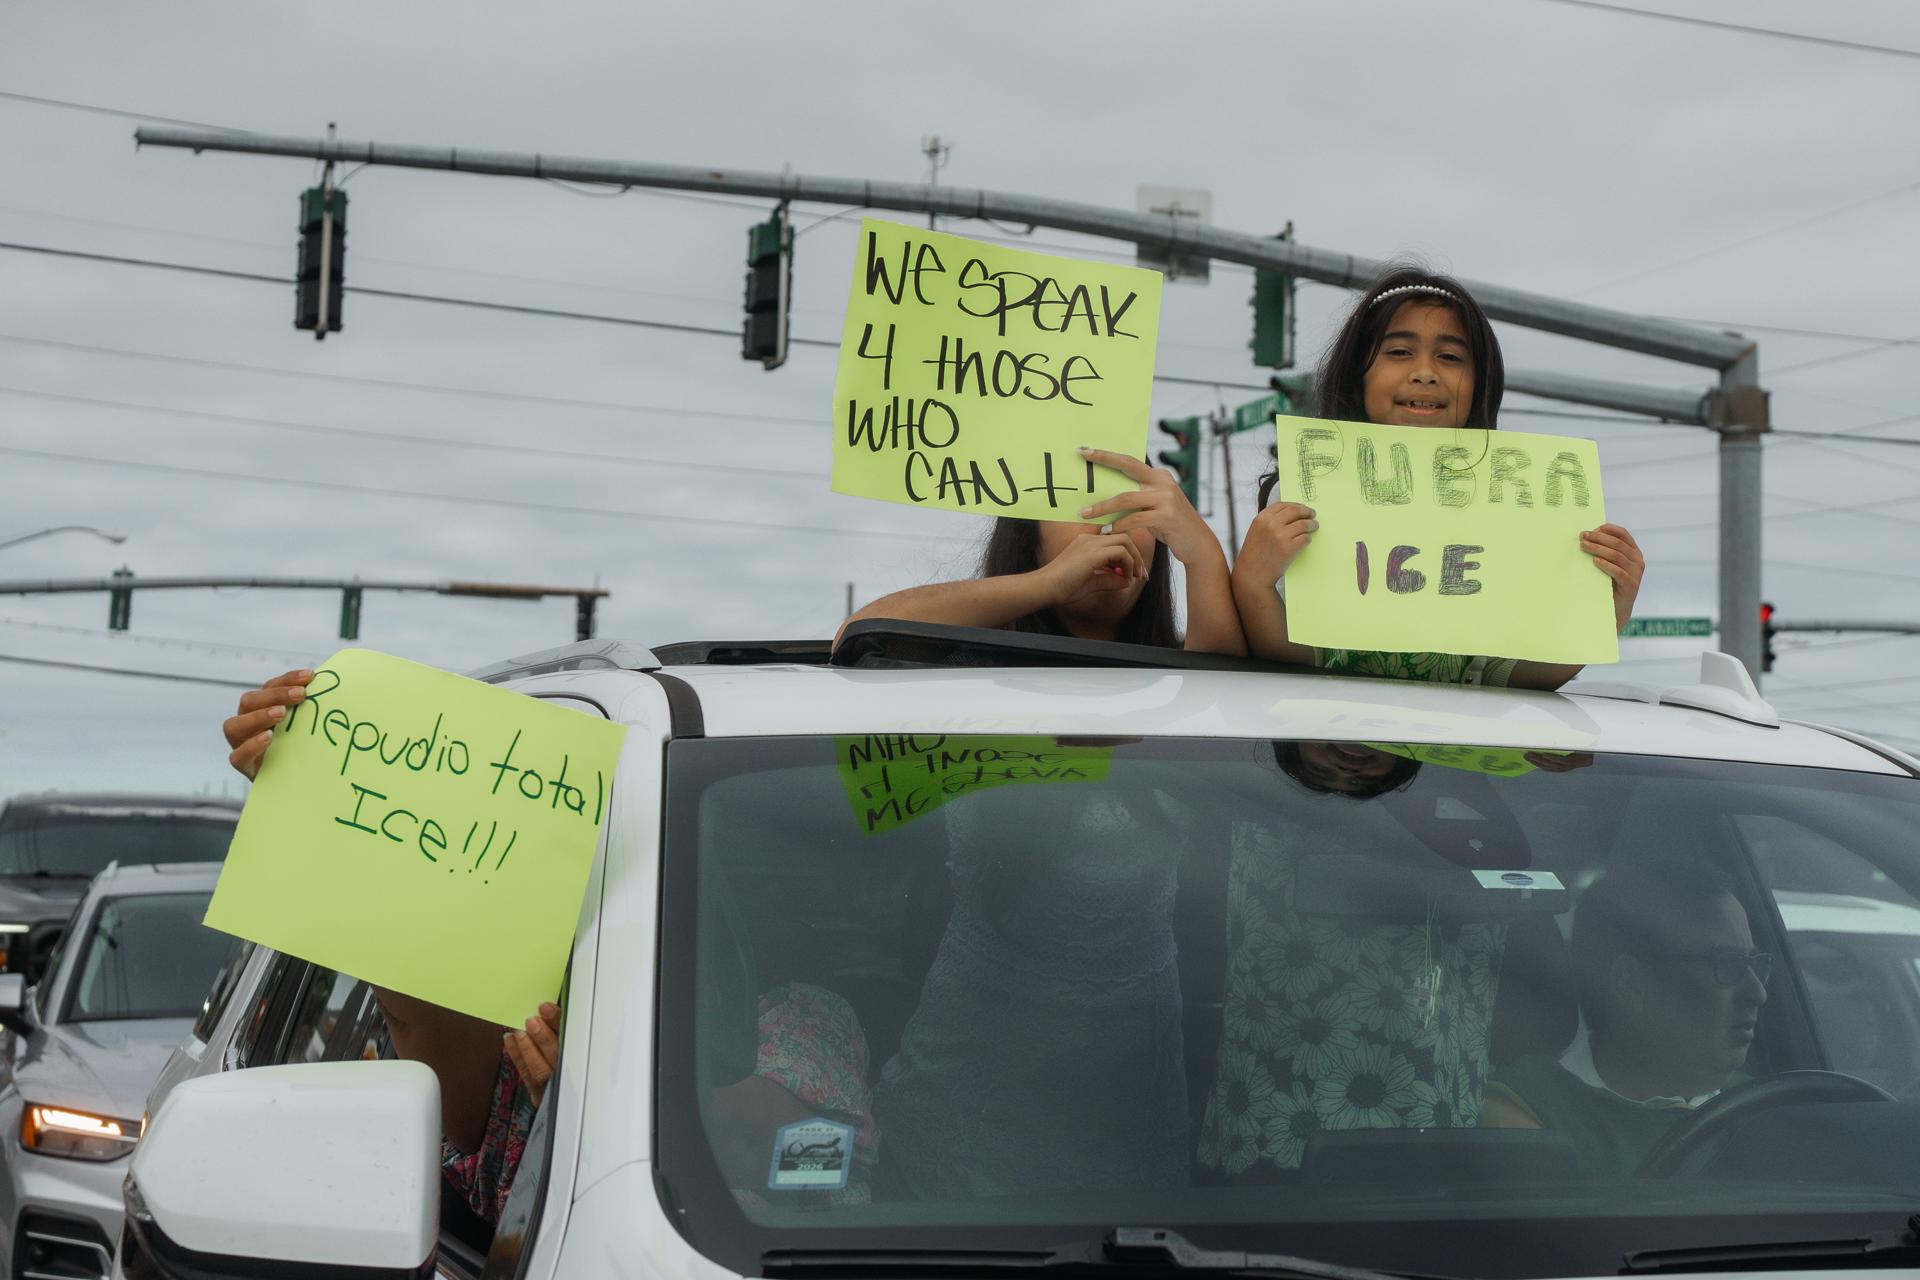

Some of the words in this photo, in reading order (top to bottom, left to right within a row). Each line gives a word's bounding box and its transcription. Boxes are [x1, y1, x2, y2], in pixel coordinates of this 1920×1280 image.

[857, 323, 895, 390] 4
[848, 396, 960, 451] WHO
[1296, 428, 1590, 509] FUERA
[285, 669, 469, 776] Repudio
[490, 729, 604, 826] total
